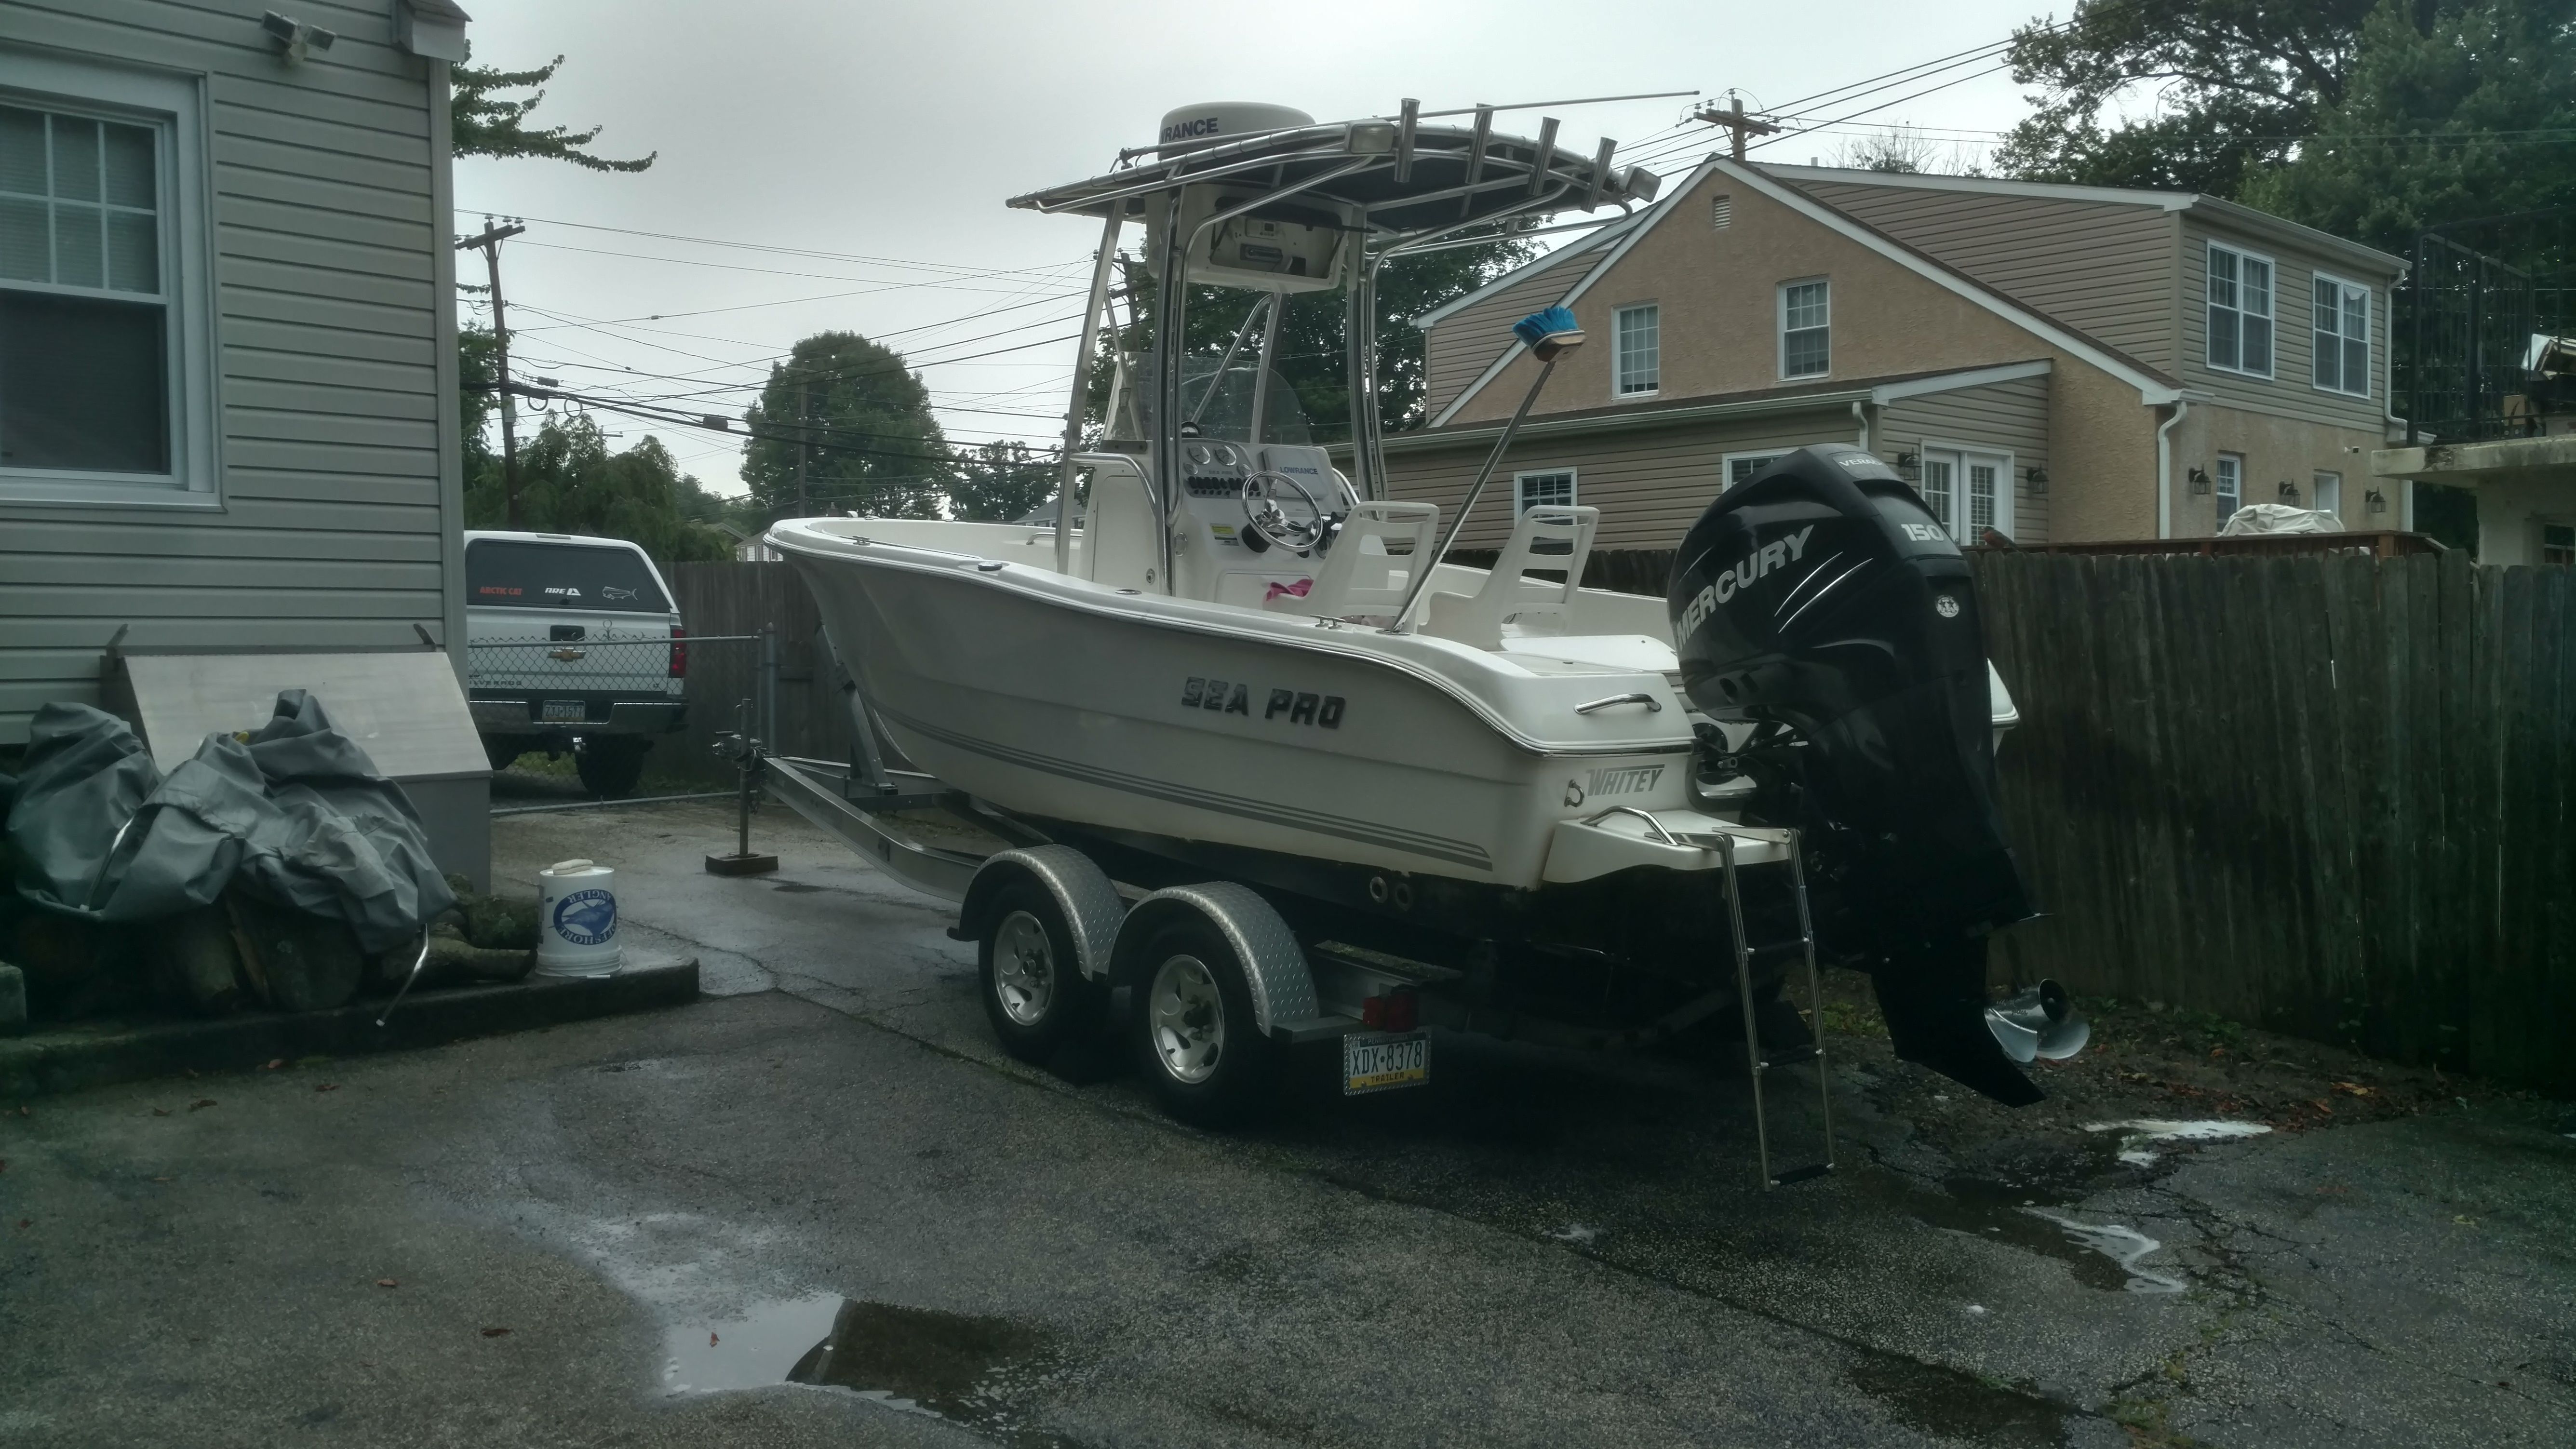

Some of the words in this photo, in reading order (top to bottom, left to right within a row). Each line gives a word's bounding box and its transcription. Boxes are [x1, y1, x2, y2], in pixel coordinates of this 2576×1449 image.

[1279, 466, 1318, 475] LOWRANCE
[1900, 523, 1944, 541] 150
[480, 586, 507, 595] ARCTIC
[1677, 524, 1814, 652] MERCURY
[1181, 676, 1249, 716] SEA
[1265, 688, 1346, 729] PRO
[1585, 764, 1665, 796] WHITEY
[568, 889, 612, 904] ANGLER
[559, 923, 617, 945] OFFSHORE
[1370, 1071, 1405, 1083] TRAILER
